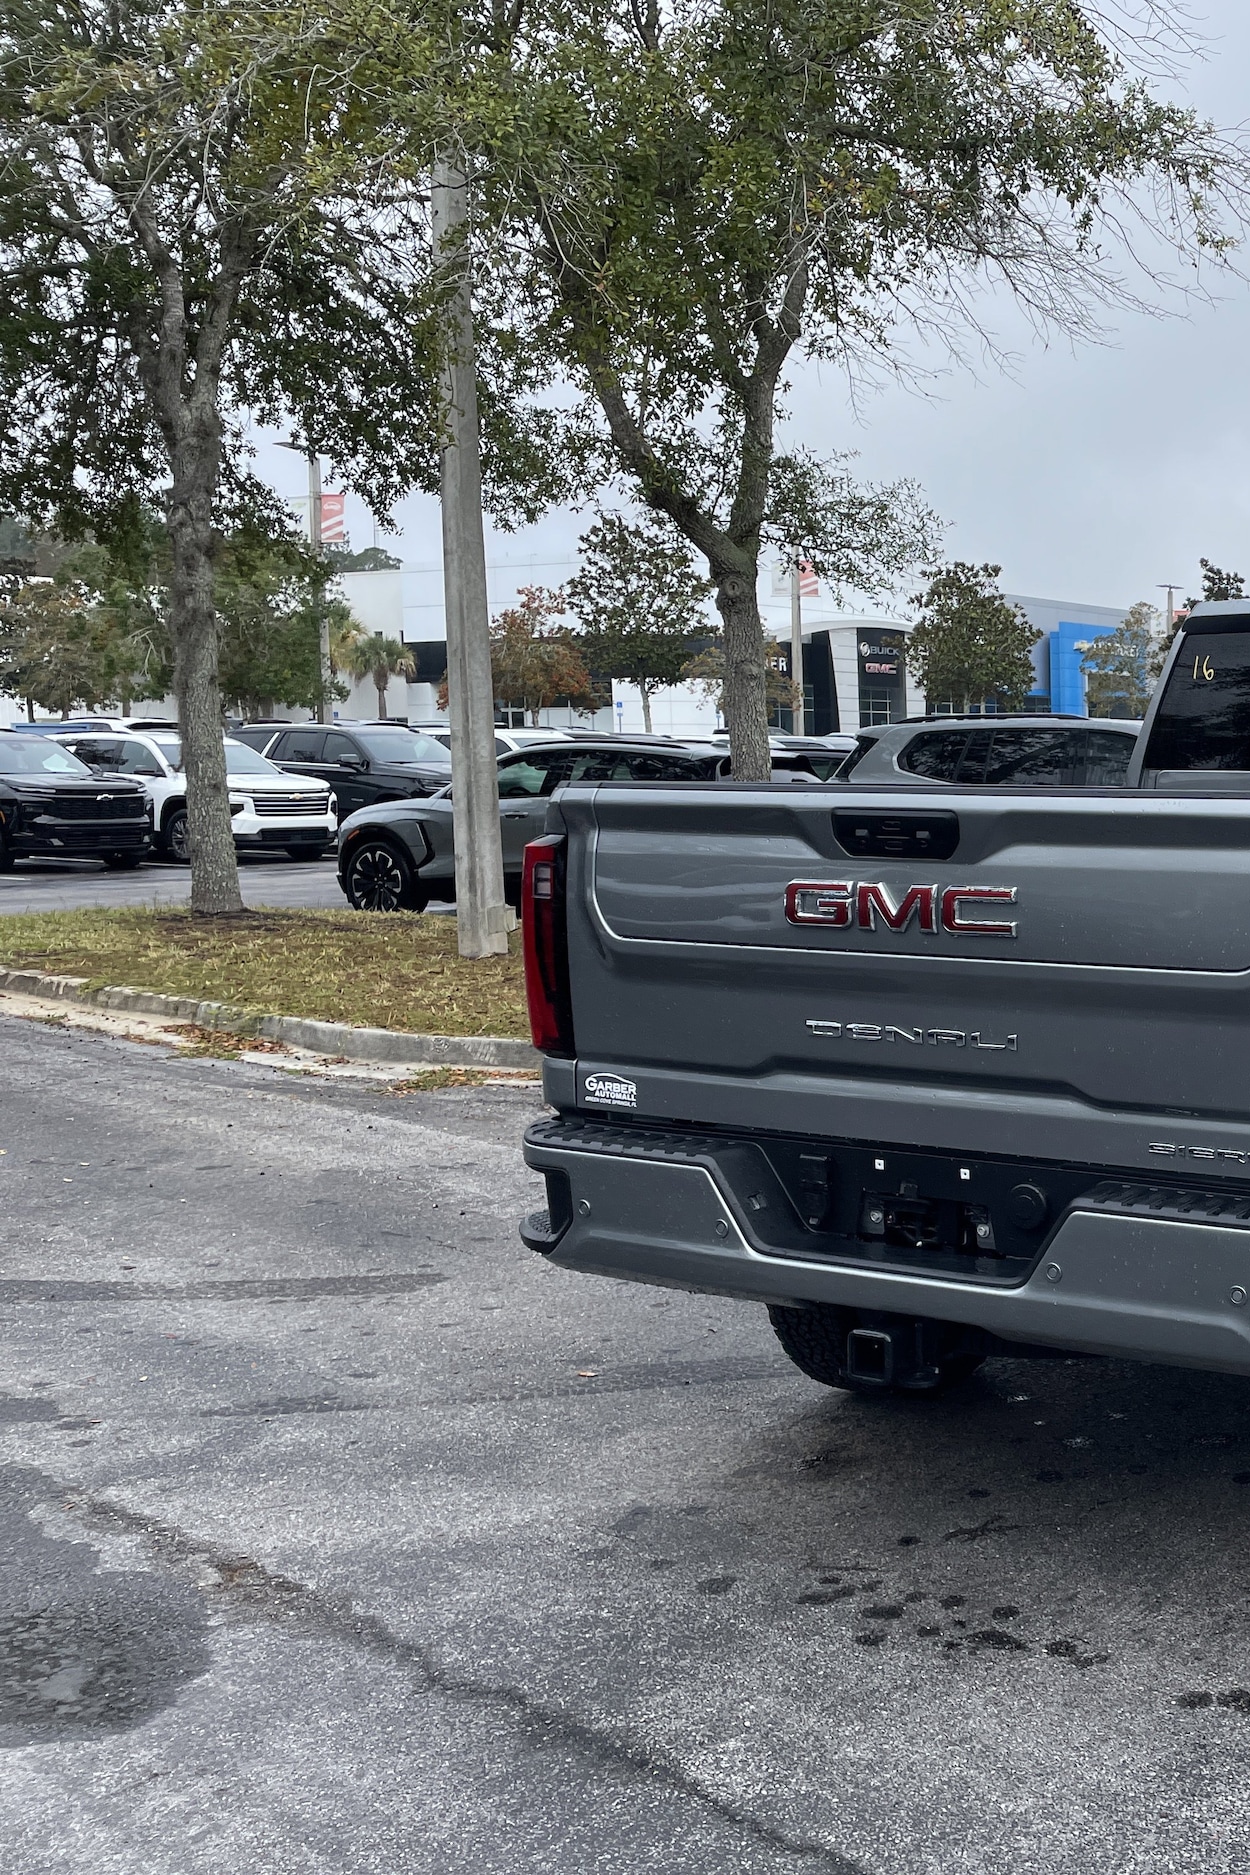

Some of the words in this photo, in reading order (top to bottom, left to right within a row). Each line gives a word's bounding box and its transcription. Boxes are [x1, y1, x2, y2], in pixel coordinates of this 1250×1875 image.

[870, 645, 900, 656] BUICK
[865, 662, 897, 675] GMC
[1193, 655, 1215, 681] 16
[784, 878, 1018, 938] GMC
[805, 1019, 1018, 1051] DENALI
[585, 1077, 637, 1095] GARBER
[594, 1090, 637, 1101] AUTOMALL
